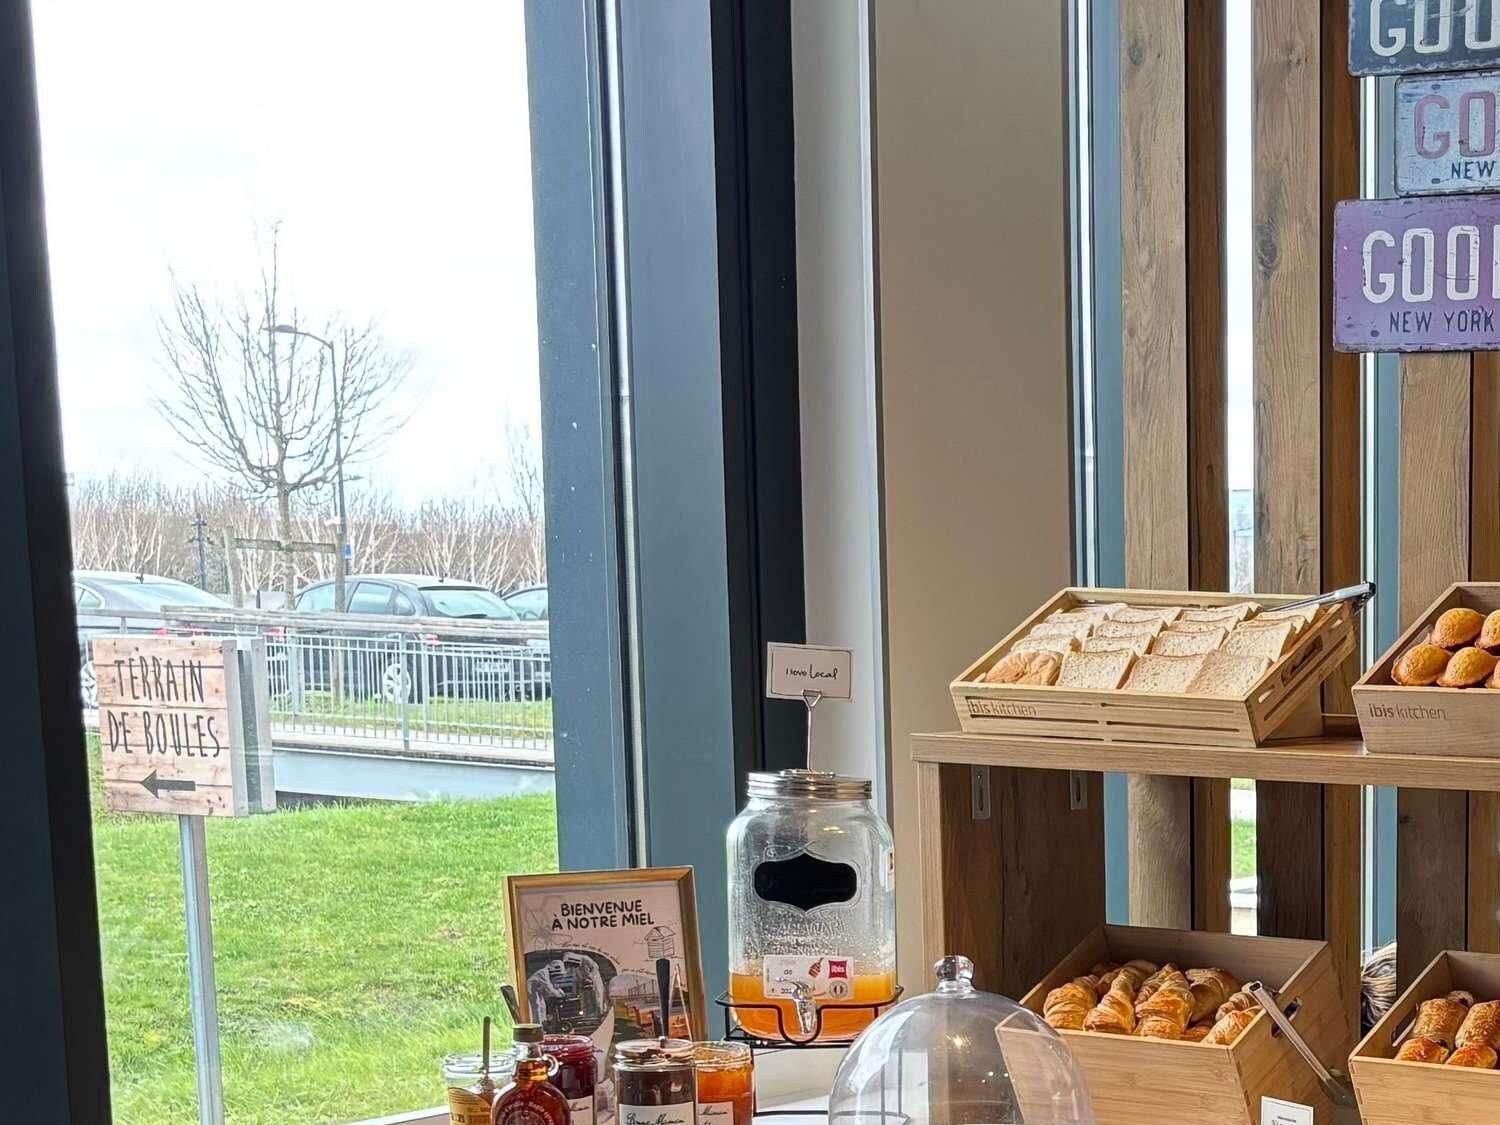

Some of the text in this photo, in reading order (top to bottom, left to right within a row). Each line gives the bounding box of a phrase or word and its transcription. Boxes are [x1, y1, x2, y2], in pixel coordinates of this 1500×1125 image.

[1451, 160, 1496, 179] NEW
[1389, 309, 1496, 333] NEW YORK
[114, 655, 205, 704] TERRAIN
[991, 701, 1038, 717] kitchen
[1368, 703, 1448, 720] ibis kitchen
[107, 710, 221, 758] DE BOULES
[560, 899, 643, 917] BIENVENUE
[551, 912, 656, 931] À NOTRE MIEL
